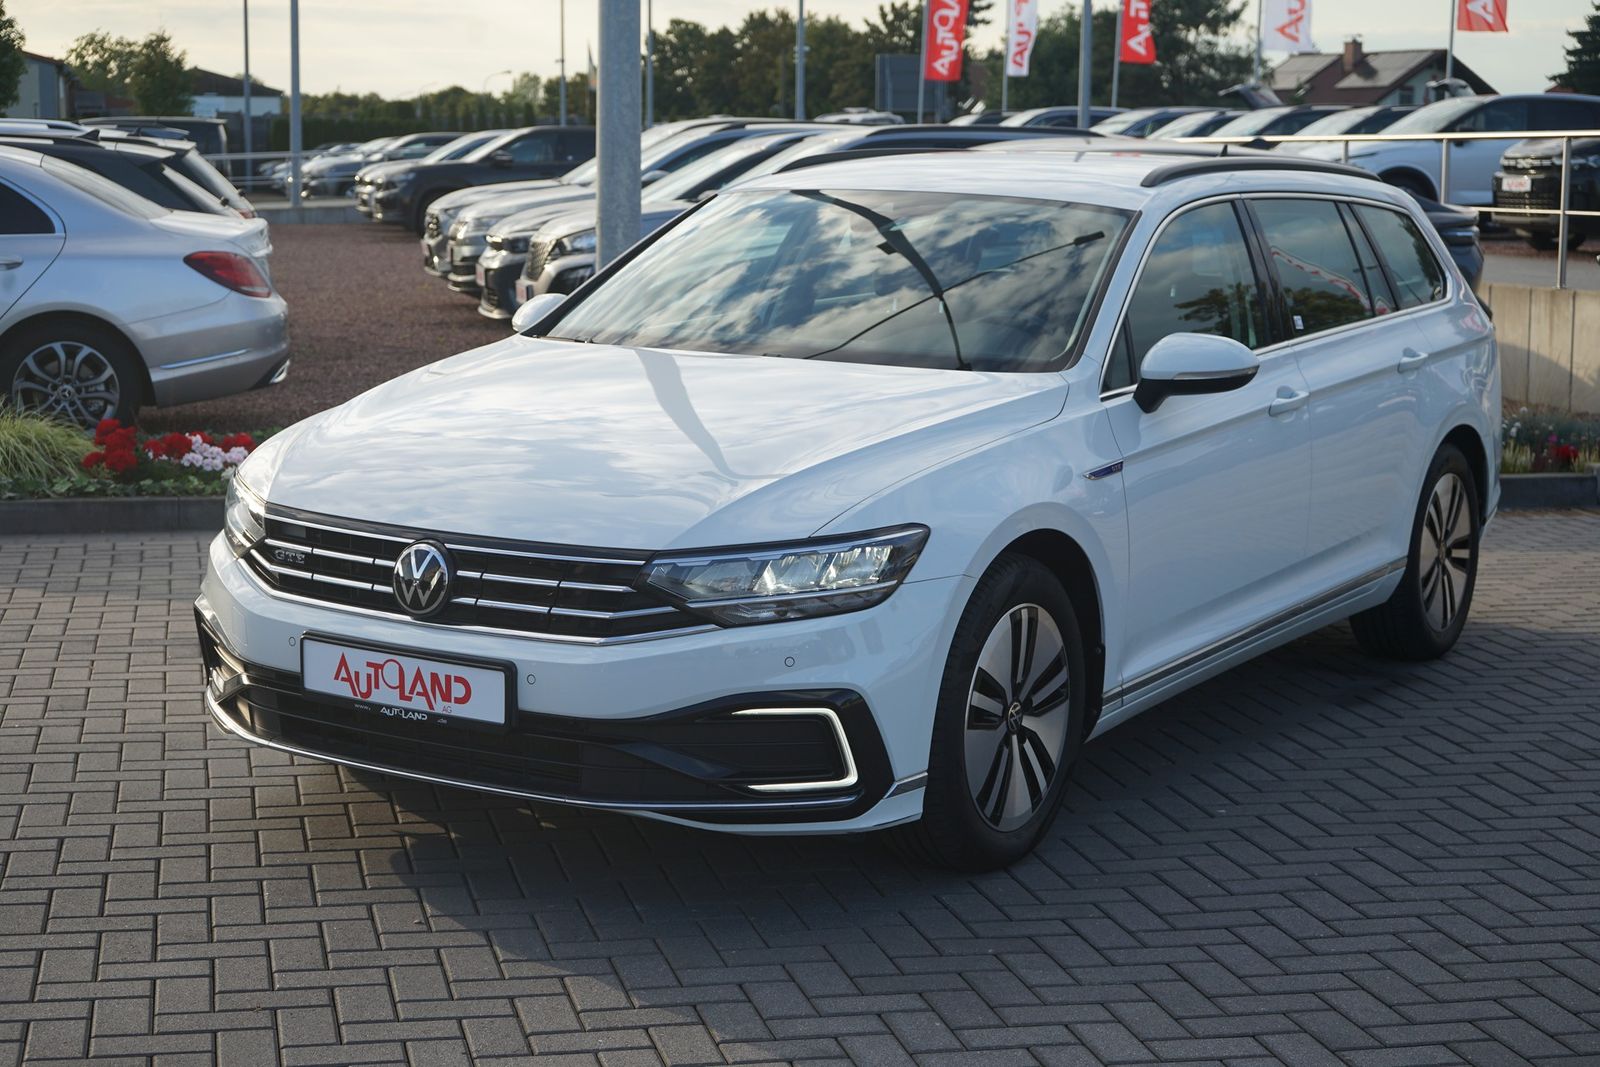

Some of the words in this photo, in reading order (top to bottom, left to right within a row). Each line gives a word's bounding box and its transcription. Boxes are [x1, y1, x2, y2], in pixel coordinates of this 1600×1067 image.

[274, 549, 305, 564] GTE
[333, 652, 472, 711] AUTOLAND
[380, 706, 428, 721] AUTOLAND
